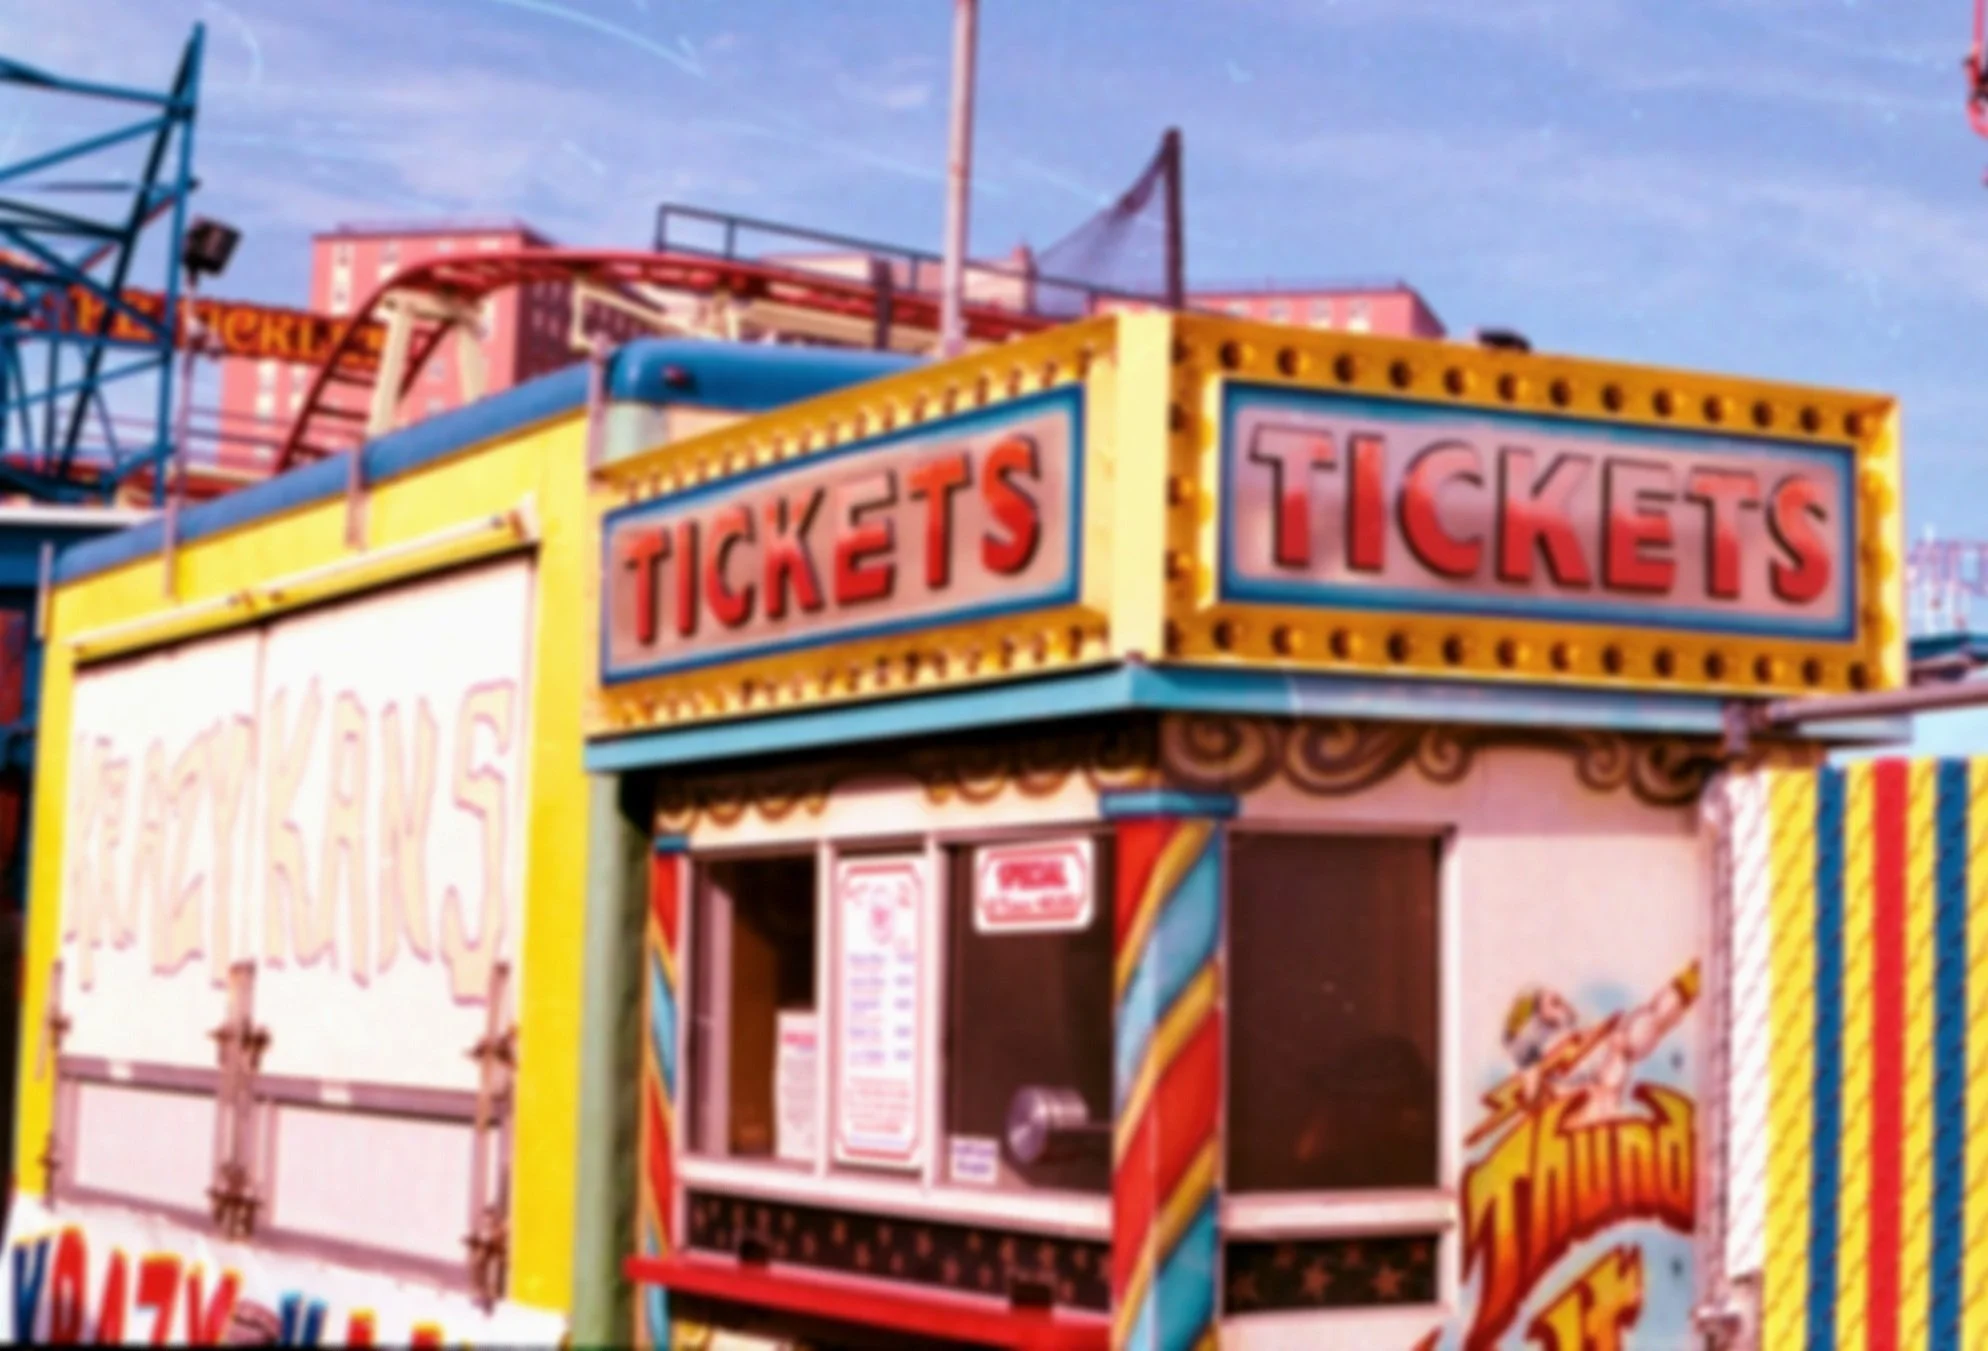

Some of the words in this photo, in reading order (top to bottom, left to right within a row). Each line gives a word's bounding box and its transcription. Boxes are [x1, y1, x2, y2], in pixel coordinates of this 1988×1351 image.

[623, 433, 1042, 649] TICKETS
[1248, 421, 1832, 605] TICKETS
[264, 673, 517, 1007] KANS
